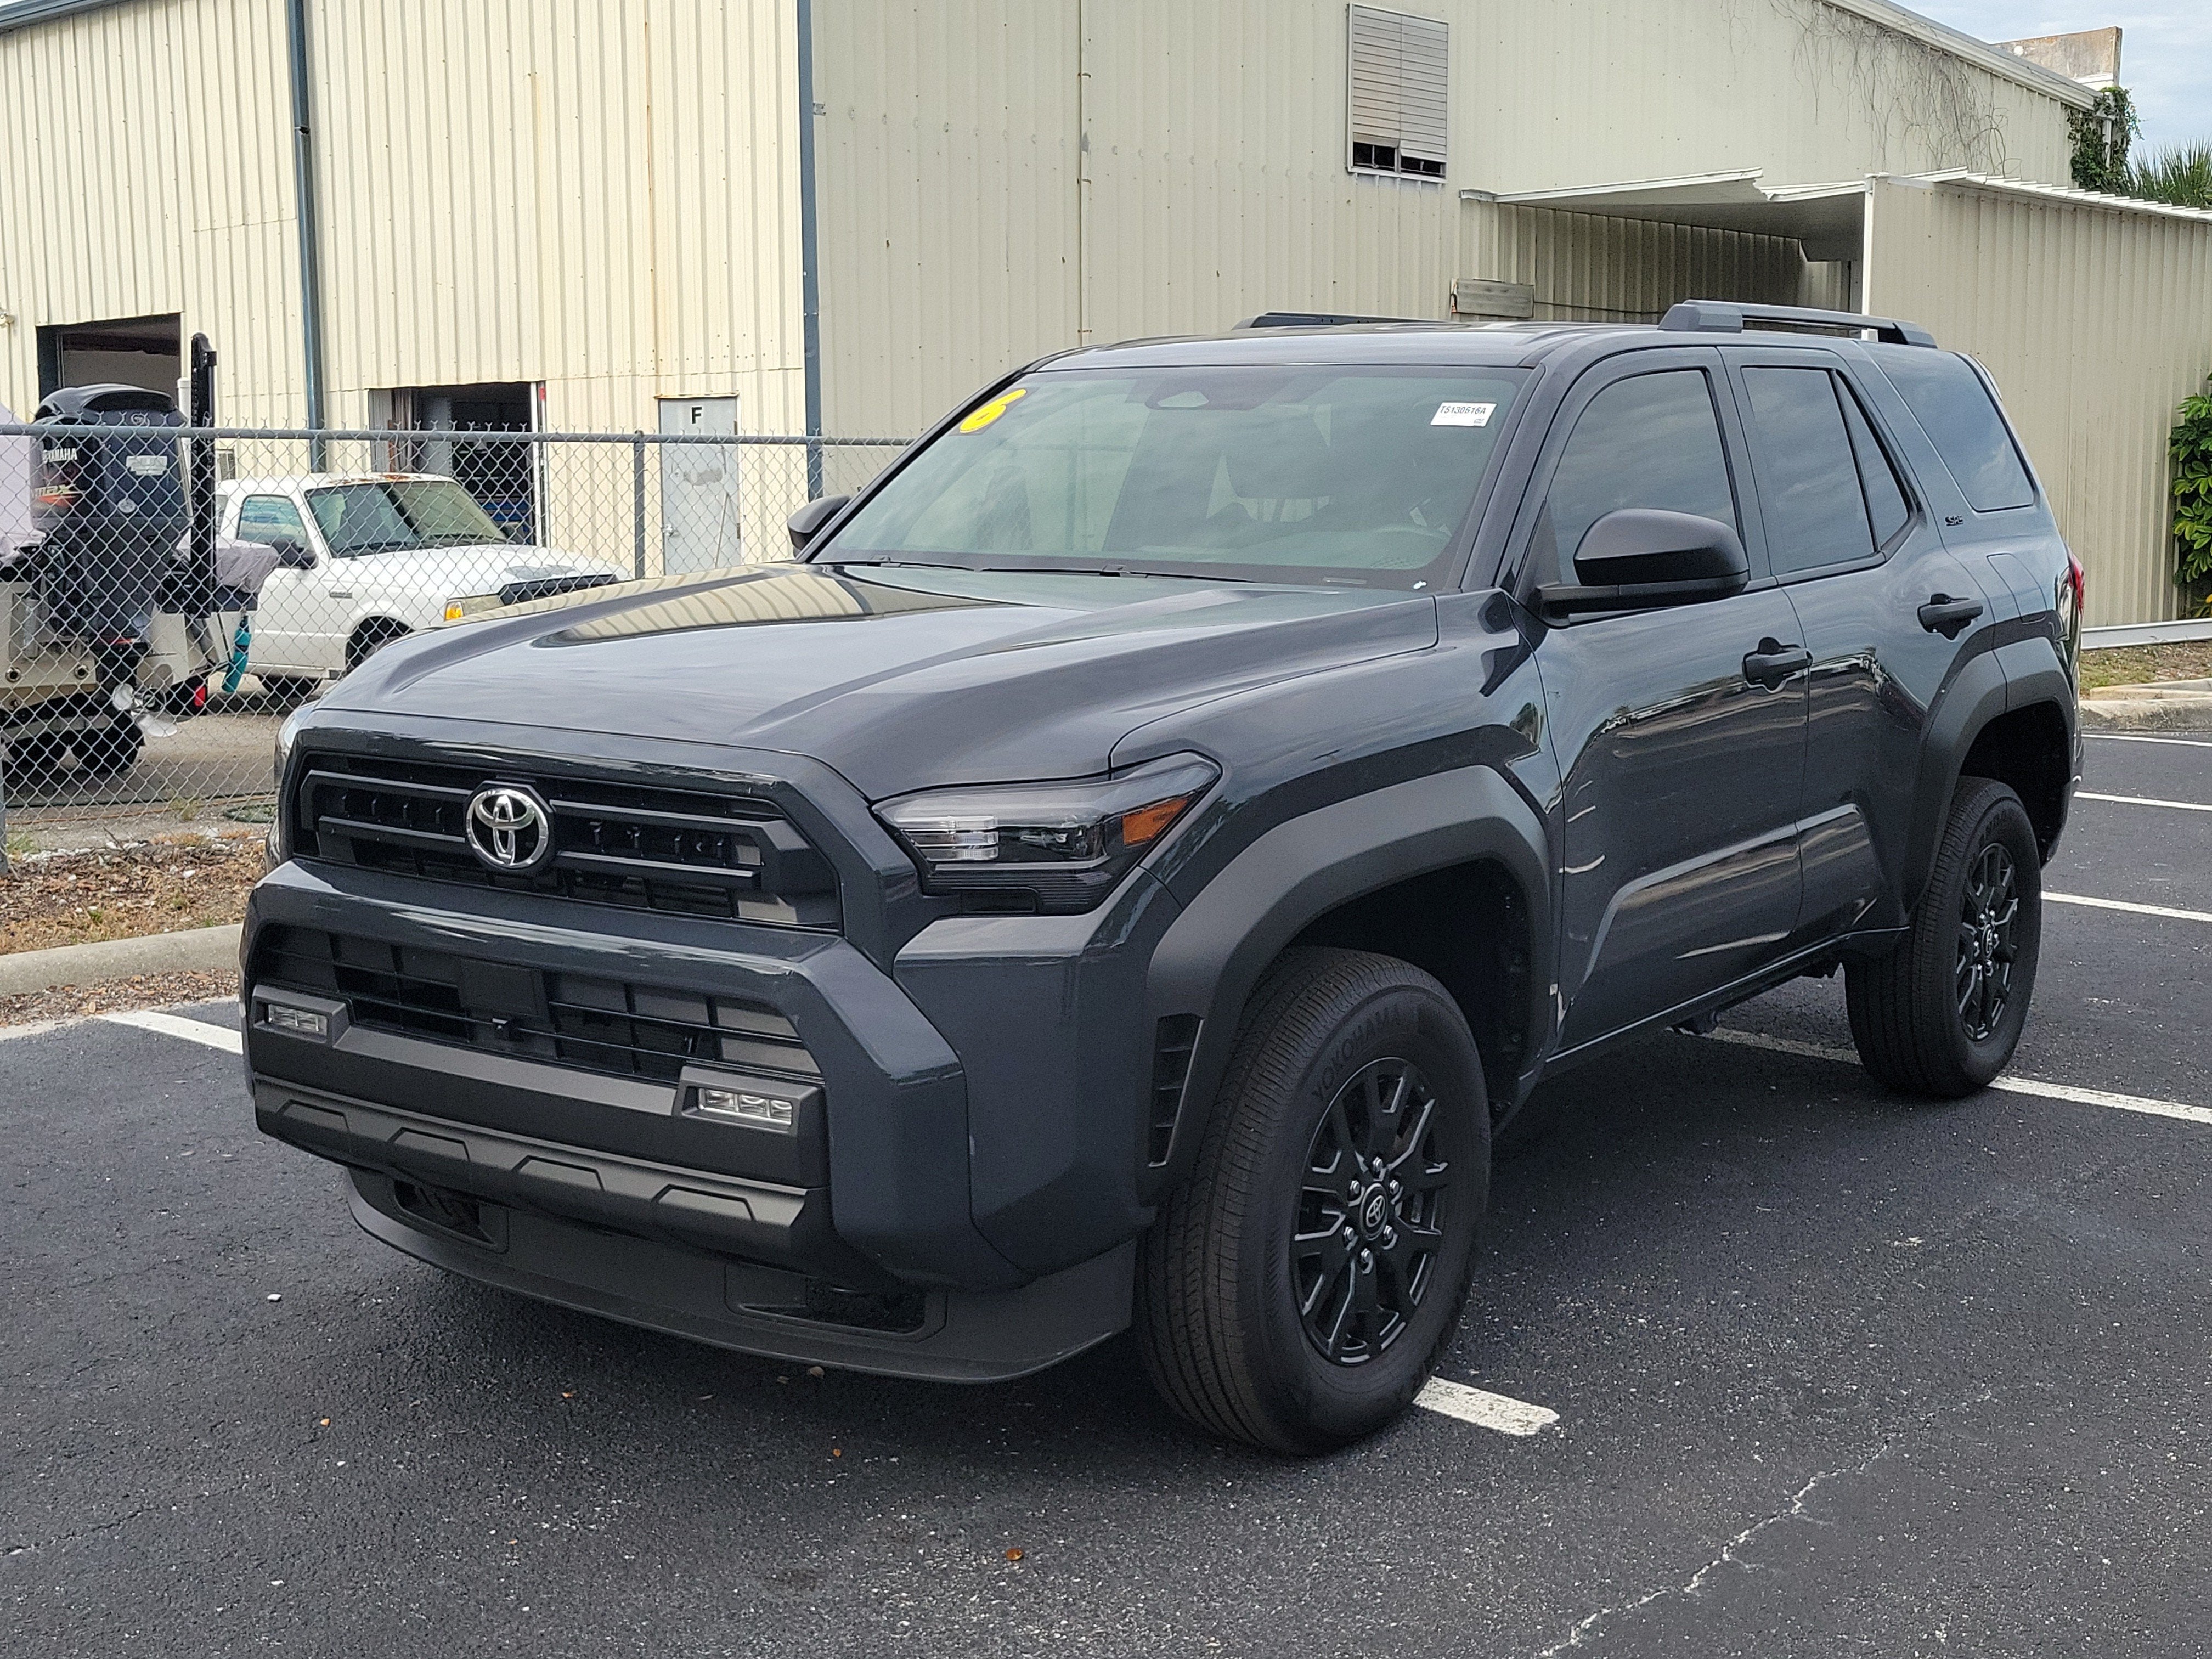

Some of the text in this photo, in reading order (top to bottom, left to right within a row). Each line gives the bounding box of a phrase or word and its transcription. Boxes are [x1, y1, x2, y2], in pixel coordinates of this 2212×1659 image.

[691, 407, 702, 425] F
[960, 388, 1026, 433] 6
[1311, 1002, 1402, 1101] YOKOHAMA
